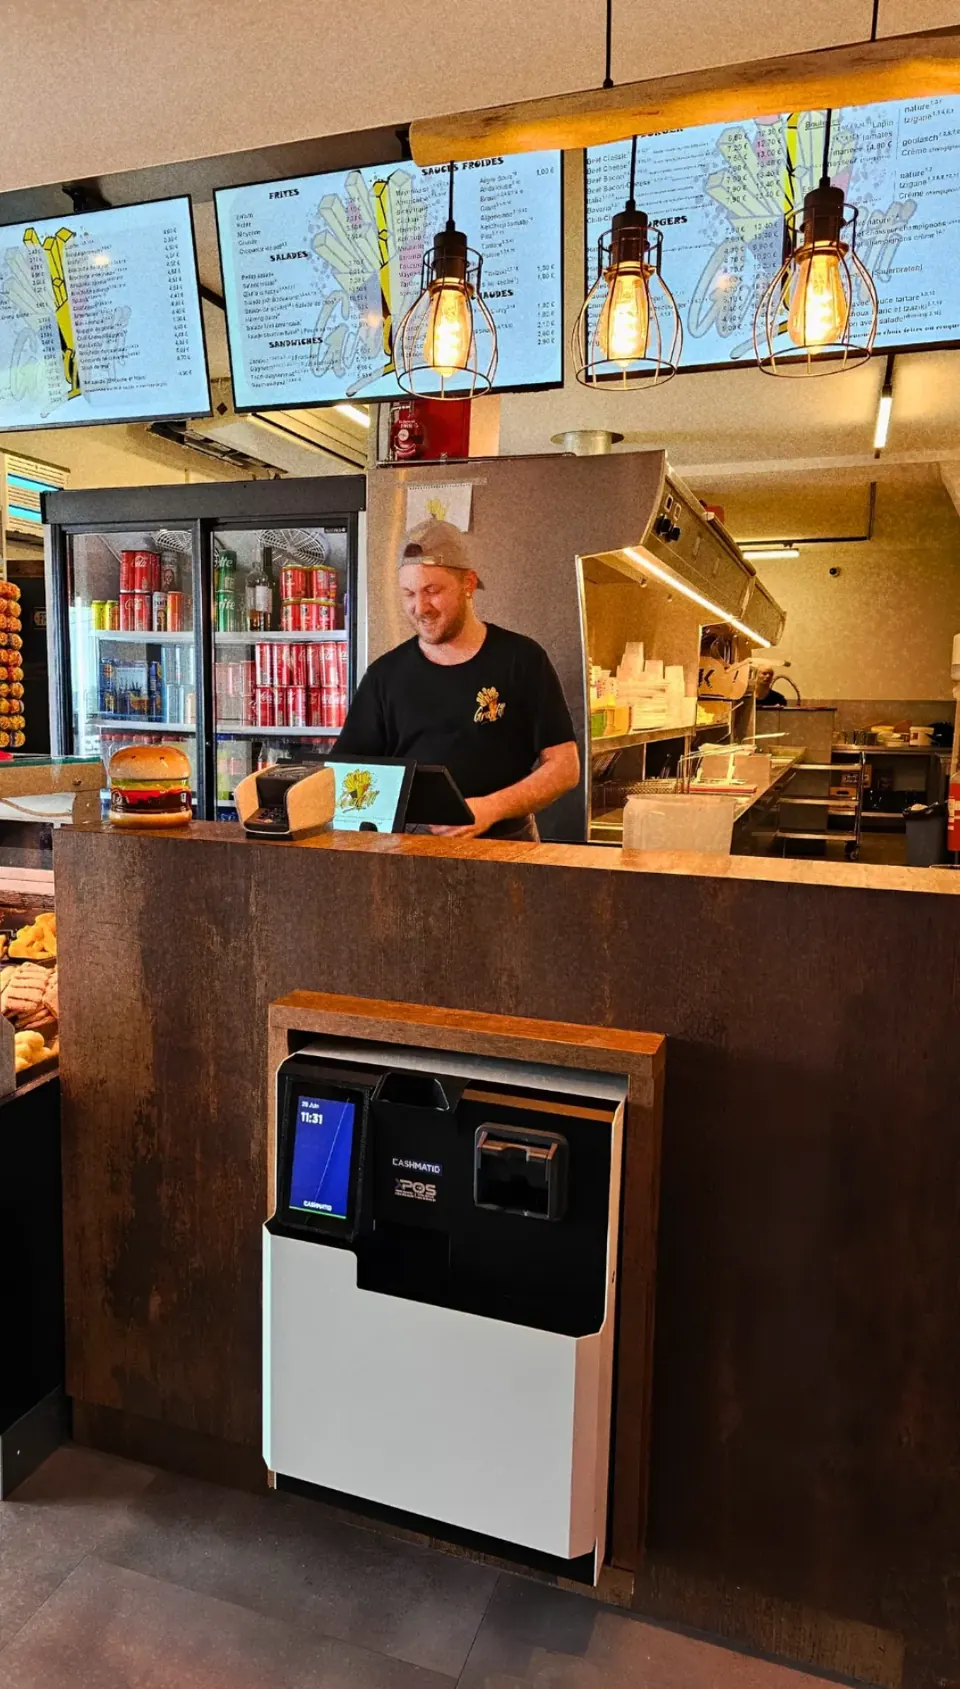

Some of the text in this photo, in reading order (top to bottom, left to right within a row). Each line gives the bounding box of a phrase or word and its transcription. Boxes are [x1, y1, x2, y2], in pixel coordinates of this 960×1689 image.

[904, 104, 930, 113] nature
[902, 134, 938, 146] goulasch
[462, 156, 504, 170] FROIDES
[900, 170, 924, 179] nature
[269, 188, 300, 200] FRITES
[648, 215, 688, 228] RGERS
[270, 250, 308, 262] SALADES
[470, 289, 514, 300] AUDES
[850, 310, 869, 318] houx
[268, 337, 324, 348] SANDWICHES
[300, 1112, 323, 1124] 11:31
